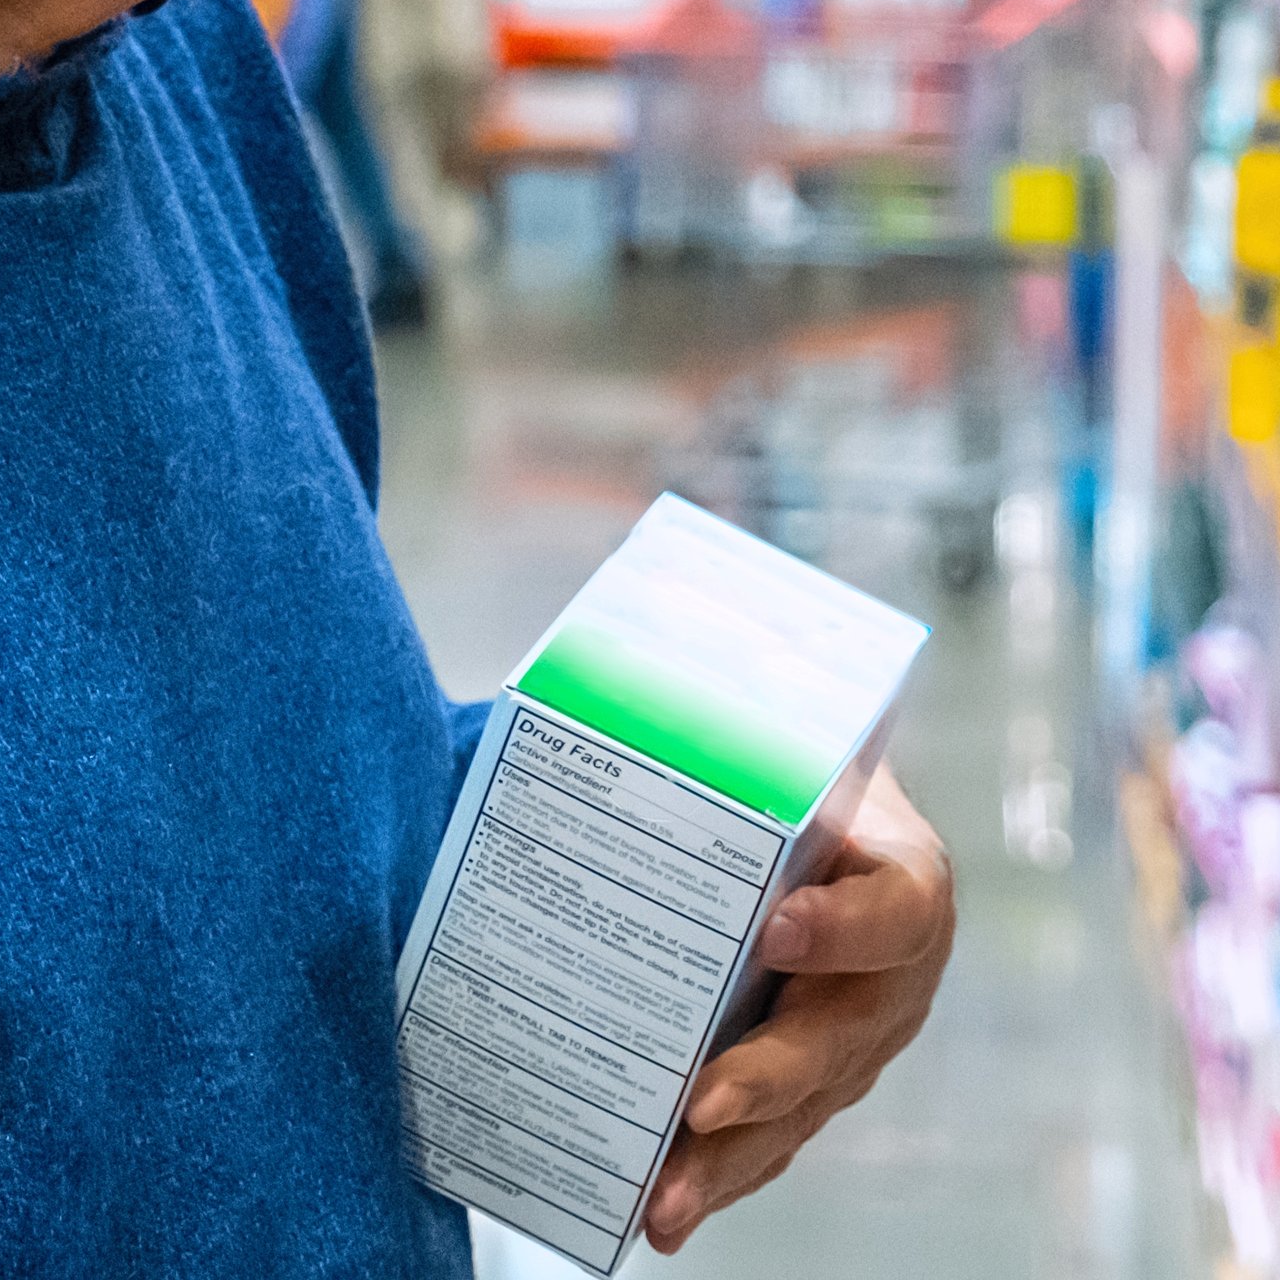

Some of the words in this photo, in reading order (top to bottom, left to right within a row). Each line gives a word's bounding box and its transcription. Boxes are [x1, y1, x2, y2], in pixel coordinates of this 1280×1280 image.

[510, 740, 549, 764] Active
[551, 760, 613, 794] ingredient
[518, 719, 566, 753] Drug
[569, 744, 622, 778] Facts
[501, 766, 531, 788] Uses
[483, 818, 538, 854] Warnings
[485, 832, 502, 846] For
[503, 844, 542, 868] external
[543, 865, 561, 878] use
[712, 839, 763, 869] Purpose
[490, 859, 508, 872] any
[564, 897, 582, 910] not
[614, 921, 640, 939] Once
[490, 869, 507, 881] not
[508, 878, 536, 897] touch
[537, 894, 582, 921] unit-dose
[584, 917, 597, 929] tip
[495, 850, 521, 867] avoid
[605, 908, 623, 920] not
[624, 915, 651, 934] touch
[652, 929, 666, 941] tip
[679, 944, 724, 968] container
[481, 874, 518, 898] solution
[520, 896, 560, 920] changes
[561, 917, 587, 934] color
[600, 936, 644, 963] becomes
[697, 984, 714, 996] not
[430, 955, 493, 993] Directions
